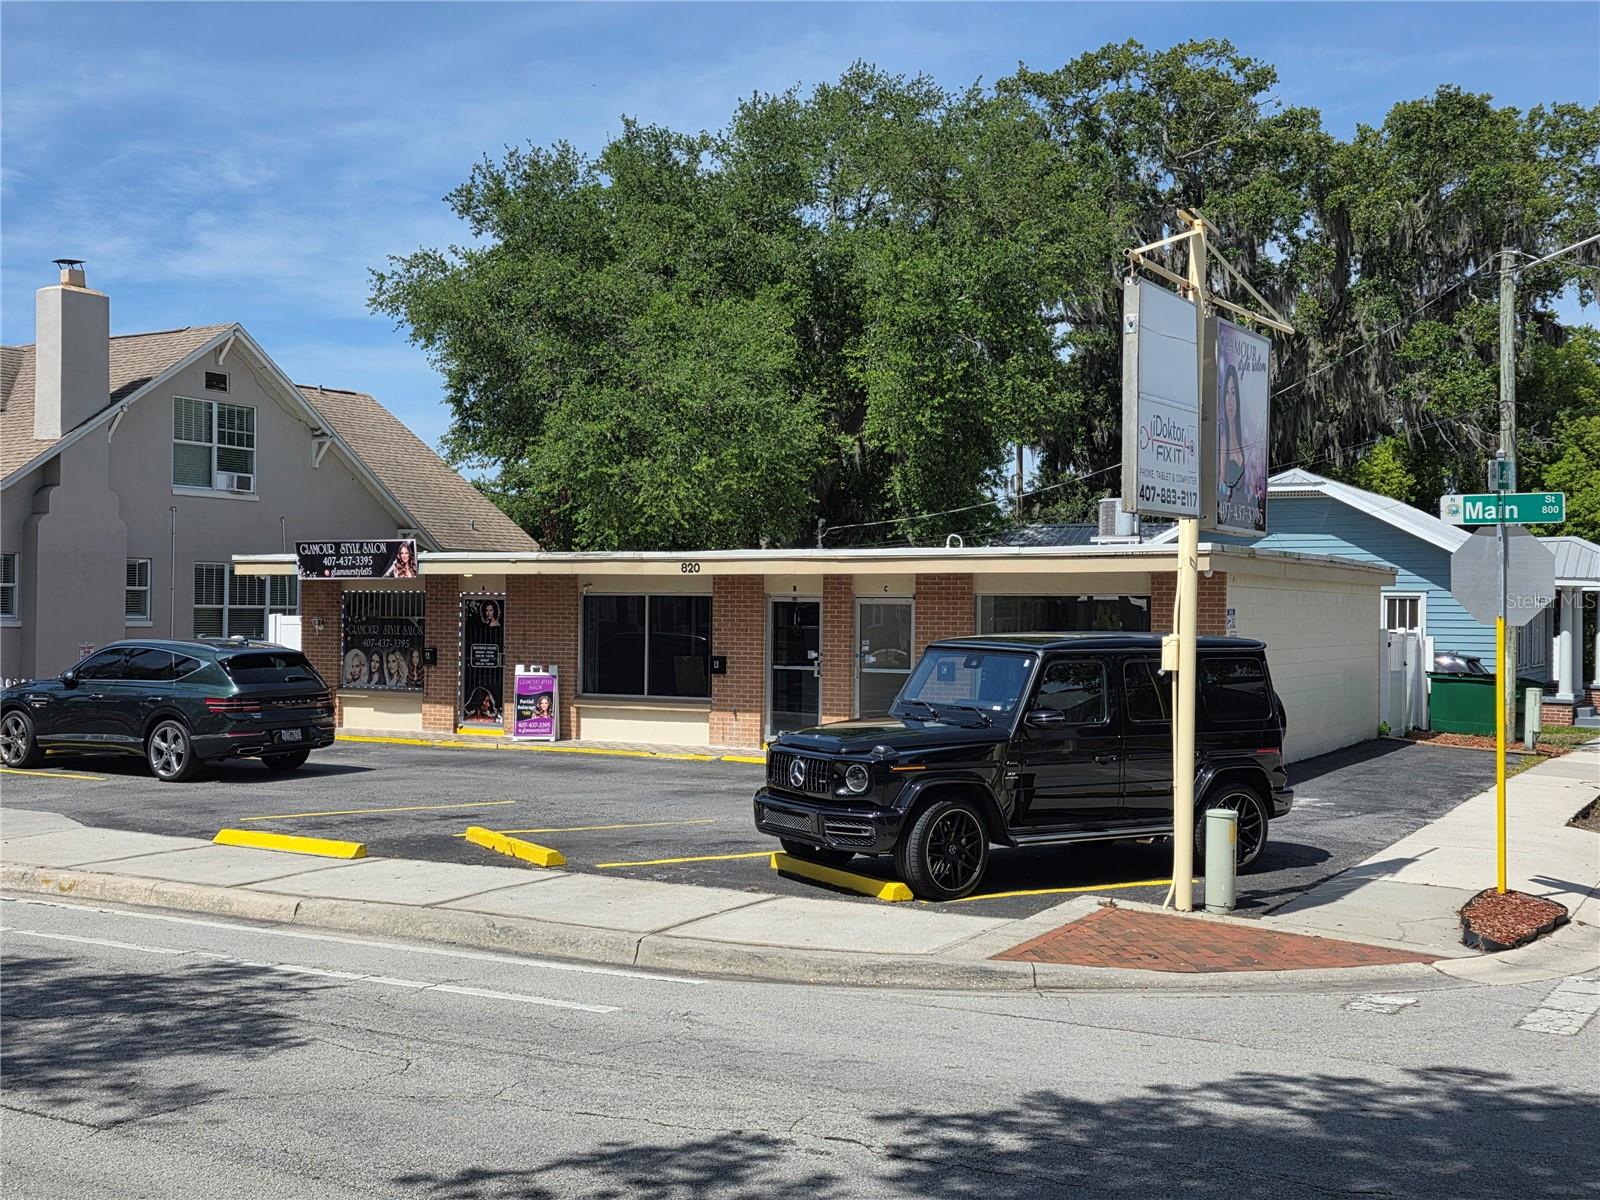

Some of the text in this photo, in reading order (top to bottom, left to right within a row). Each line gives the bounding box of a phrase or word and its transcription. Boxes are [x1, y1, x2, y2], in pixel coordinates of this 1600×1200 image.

[1220, 335, 1257, 363] GLAMOUR
[1152, 414, 1185, 443] iDoktor
[1156, 444, 1172, 463] FIX
[1156, 469, 1172, 482] TABLET
[1176, 472, 1197, 486] COMPUTER
[1139, 484, 1198, 508] 407-883-2117
[1544, 495, 1556, 504] St
[1465, 501, 1518, 520] Main
[1541, 505, 1560, 514] 800
[299, 542, 387, 555] GLAMOUR STYLE SALON
[322, 556, 373, 566] 407-437-3395
[681, 562, 700, 574] 820
[347, 624, 424, 636] GLAMOUR STYLE SALON
[362, 638, 410, 648] 407-437-3395
